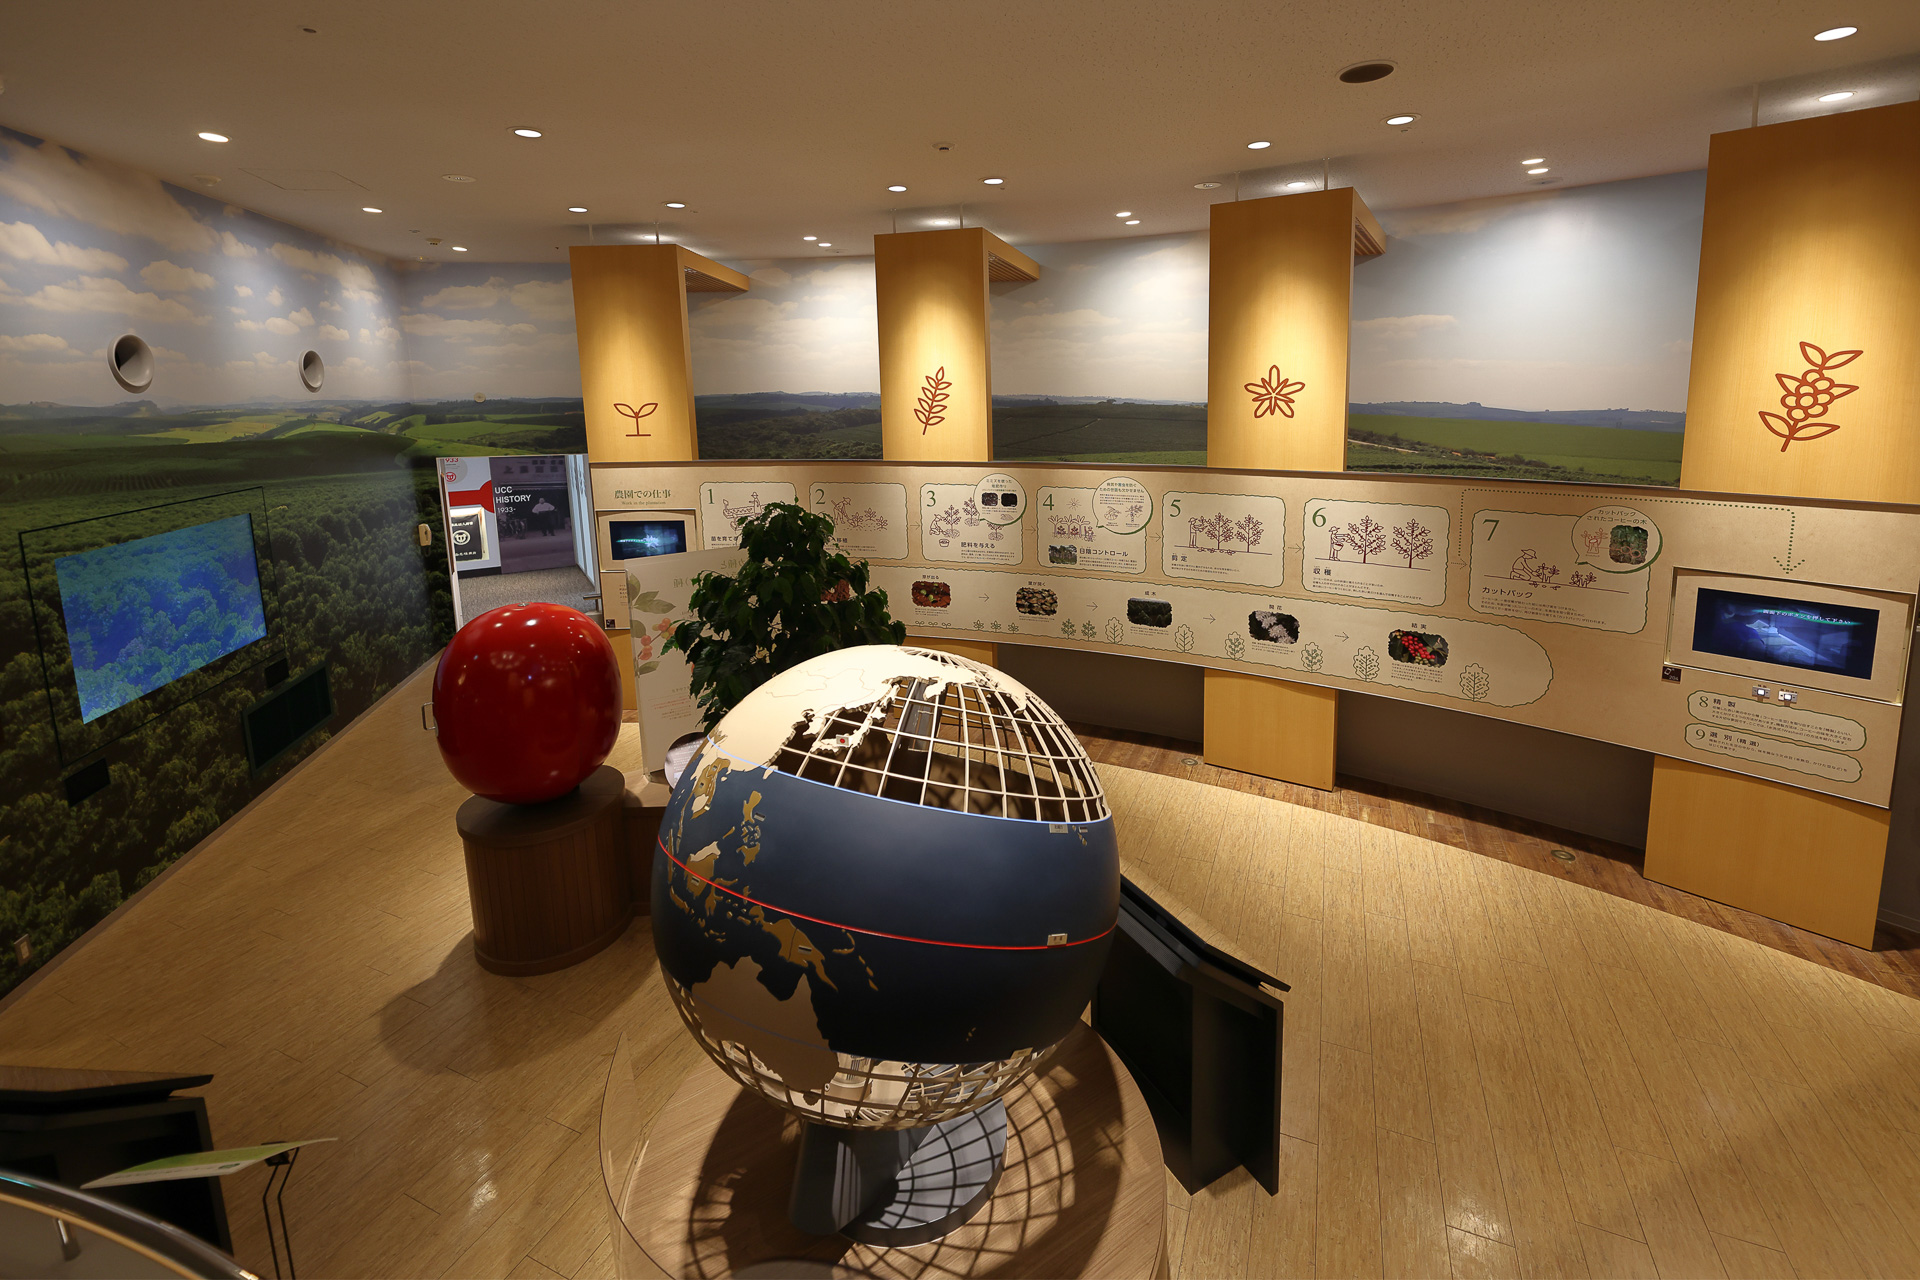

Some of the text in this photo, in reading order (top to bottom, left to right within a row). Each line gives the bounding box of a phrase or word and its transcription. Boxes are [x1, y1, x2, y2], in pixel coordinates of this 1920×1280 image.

[495, 486, 513, 494] UCC
[614, 489, 672, 499] 農園での仕事
[708, 488, 715, 504] 1
[815, 489, 826, 505] 2
[496, 494, 532, 504] HISTORY
[926, 490, 937, 507] 3
[1042, 494, 1055, 511] 4
[1169, 499, 1181, 518] 5
[1312, 507, 1327, 528] 6
[1586, 516, 1648, 525] されたコーヒーの木
[1482, 518, 1500, 541] 7
[1482, 586, 1533, 599] カットバック
[1699, 696, 1709, 708] 8
[1695, 729, 1706, 740] 9
